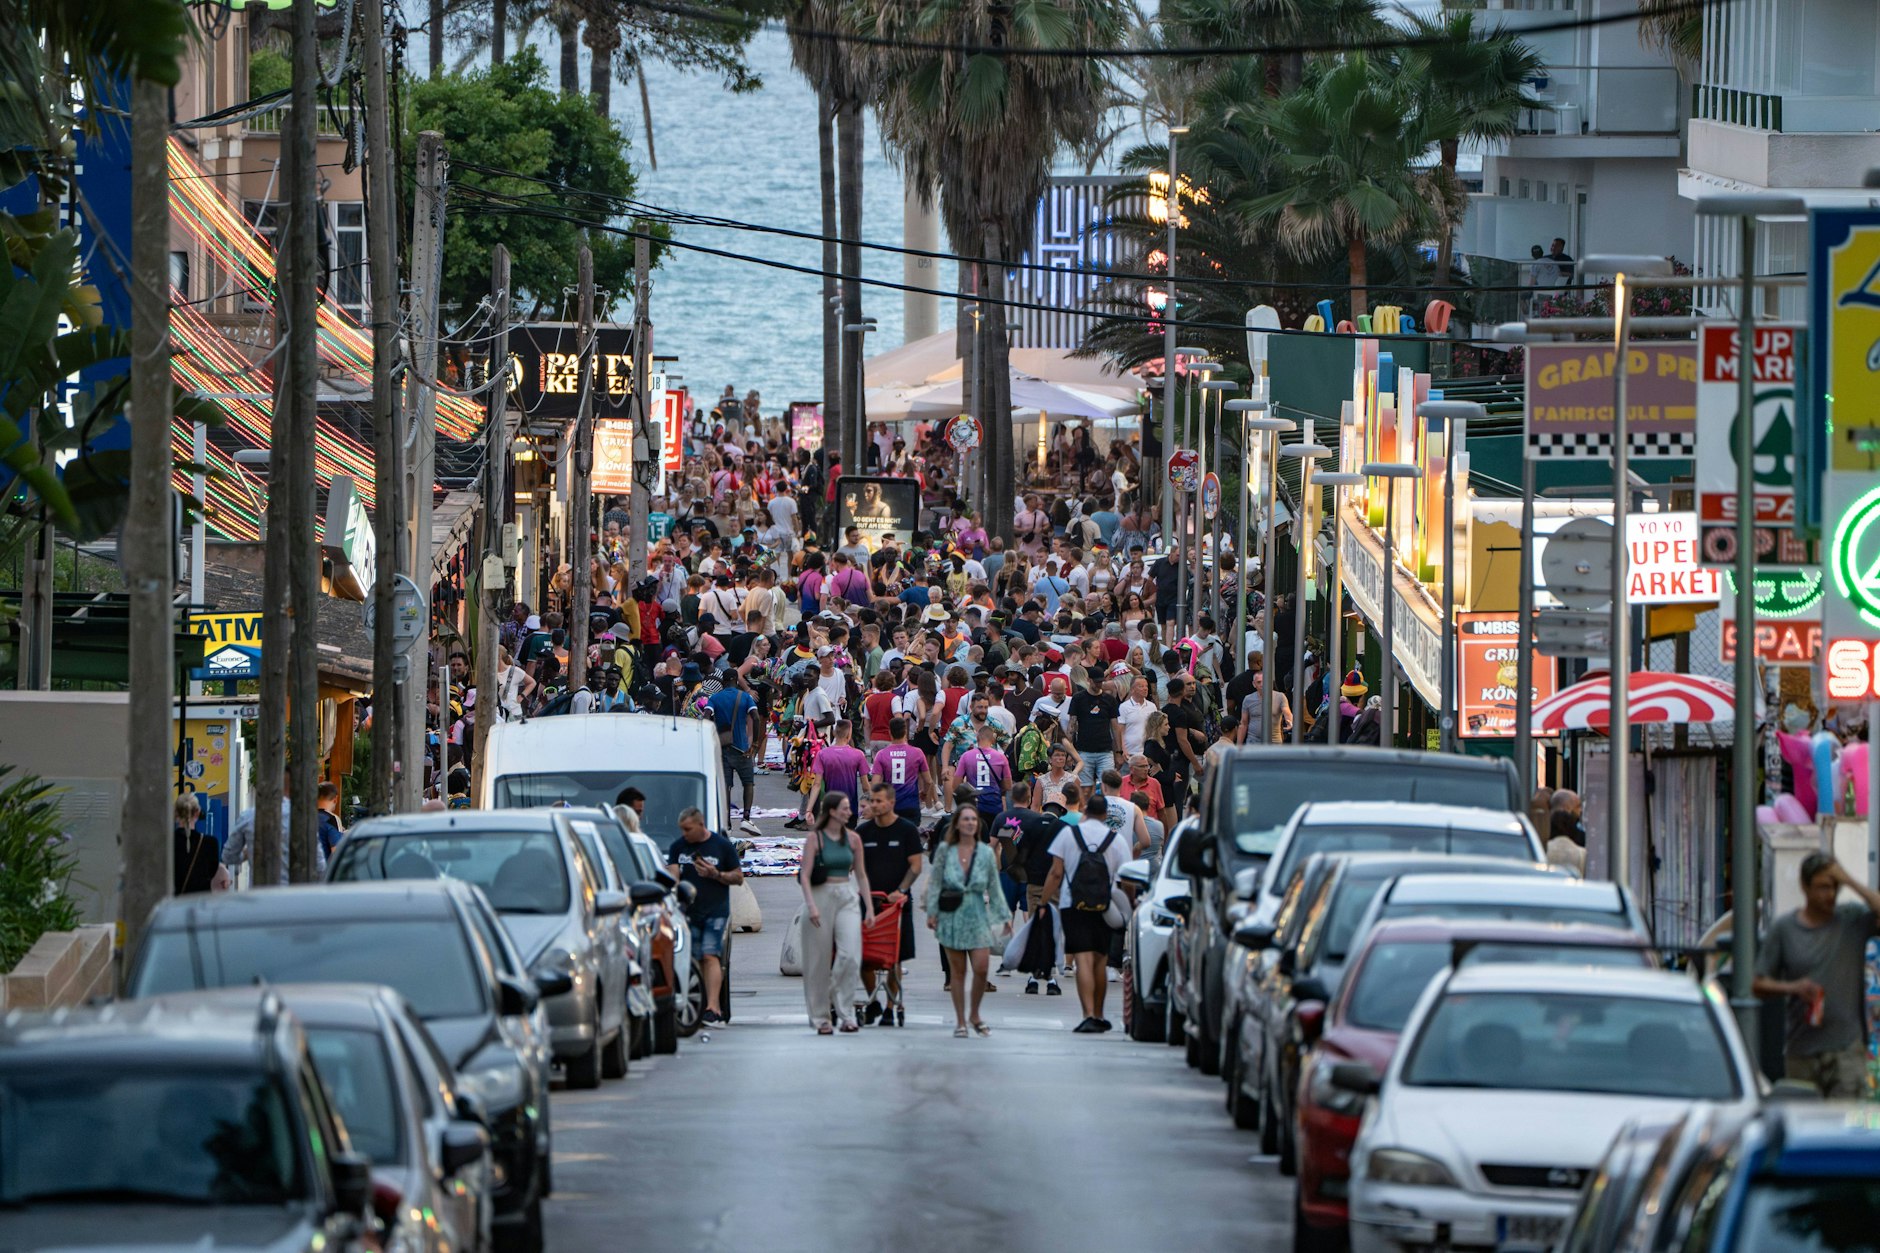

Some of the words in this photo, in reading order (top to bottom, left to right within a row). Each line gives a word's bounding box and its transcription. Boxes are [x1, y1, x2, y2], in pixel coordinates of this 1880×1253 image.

[546, 353, 634, 374] PATY
[546, 374, 634, 394] KEER
[1703, 527, 1821, 563] OPE
[197, 617, 264, 642] ATM
[1481, 684, 1539, 701] KÖNG
[891, 758, 906, 785] 8
[976, 761, 991, 787] 8
